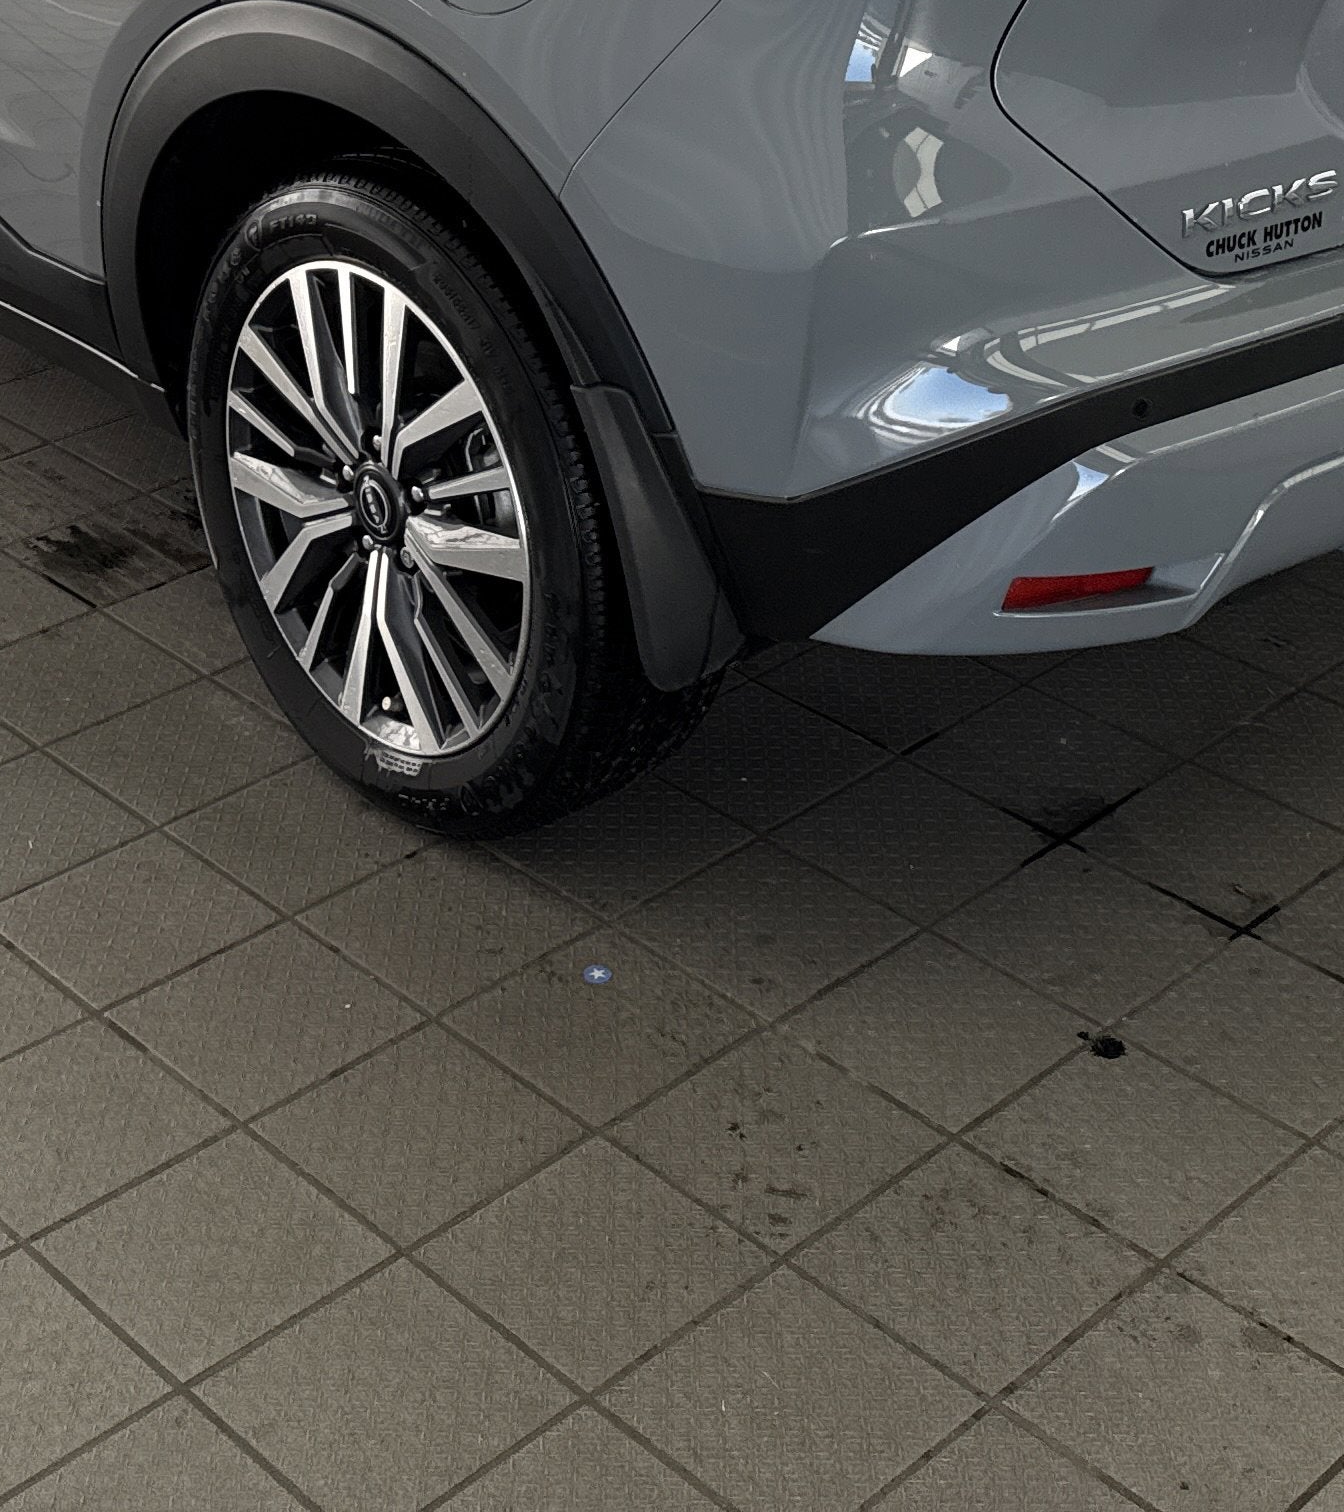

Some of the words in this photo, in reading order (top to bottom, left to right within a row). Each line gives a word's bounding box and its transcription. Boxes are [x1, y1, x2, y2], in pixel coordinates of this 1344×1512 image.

[1181, 169, 1339, 238] KICKS
[1206, 229, 1258, 258] CHUCK
[1263, 211, 1323, 243] HUTTON
[1234, 238, 1295, 263] NISSAN
